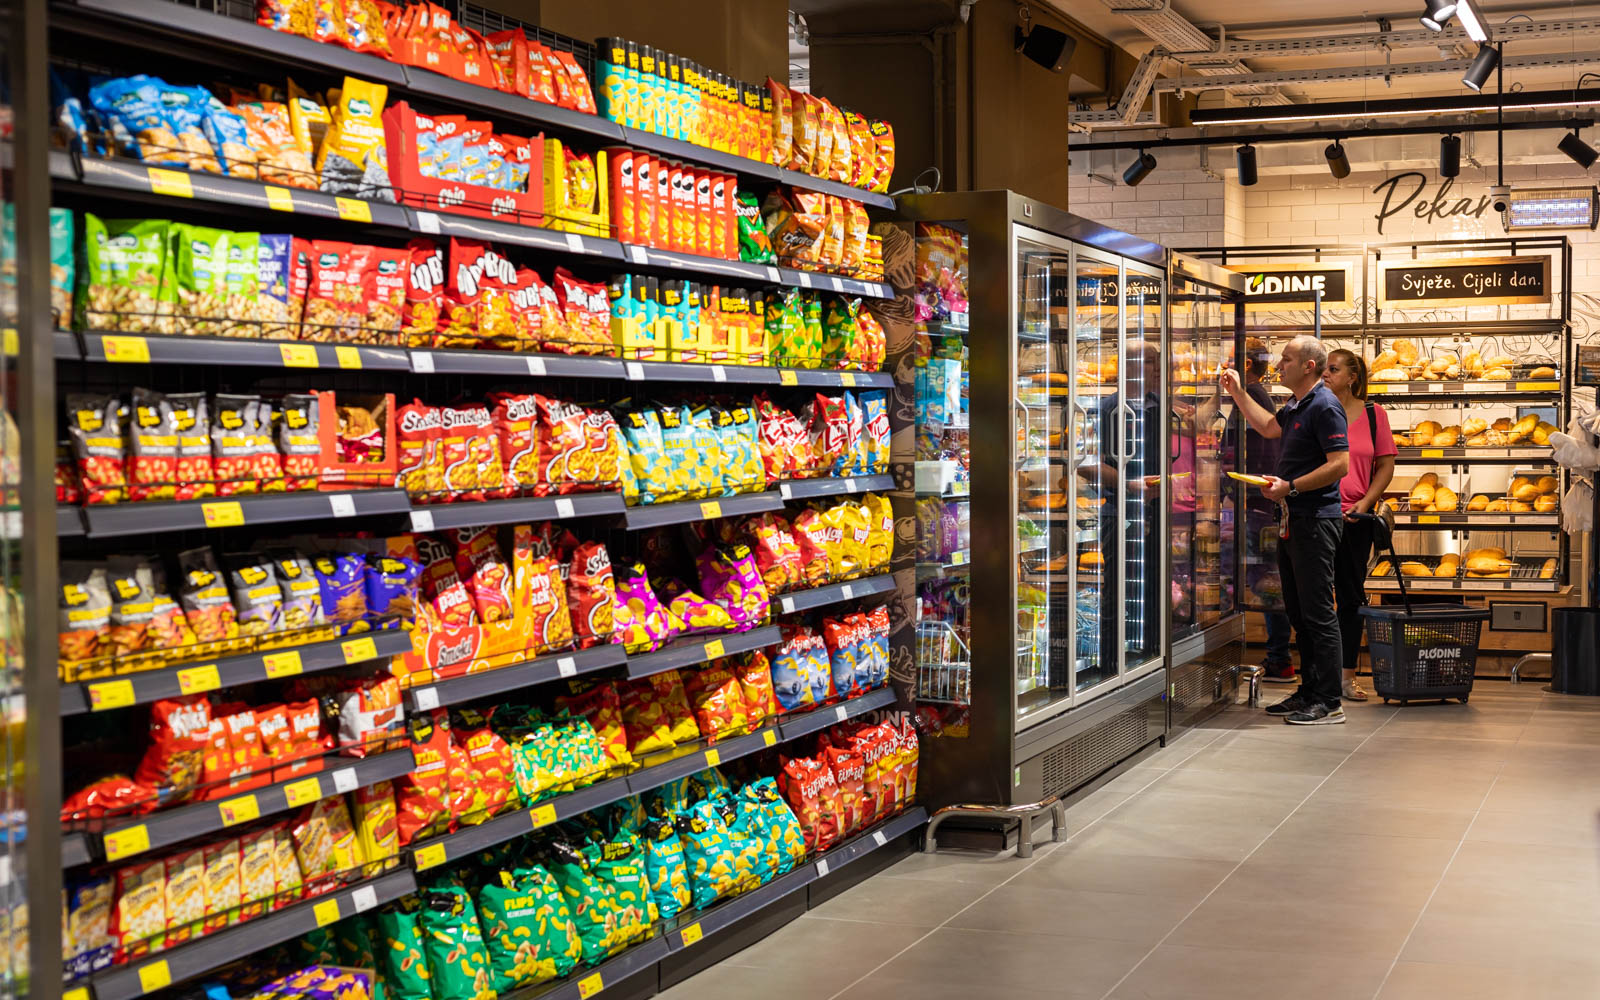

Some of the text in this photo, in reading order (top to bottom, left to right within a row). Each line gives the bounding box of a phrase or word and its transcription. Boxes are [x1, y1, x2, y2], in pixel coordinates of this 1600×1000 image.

[1245, 275, 1326, 297] ODINE
[1402, 270, 1541, 297] Svježe. Cijeli dan.
[532, 589, 550, 606] ack
[1418, 648, 1461, 660] PLODINE
[503, 895, 534, 911] FLIPS
